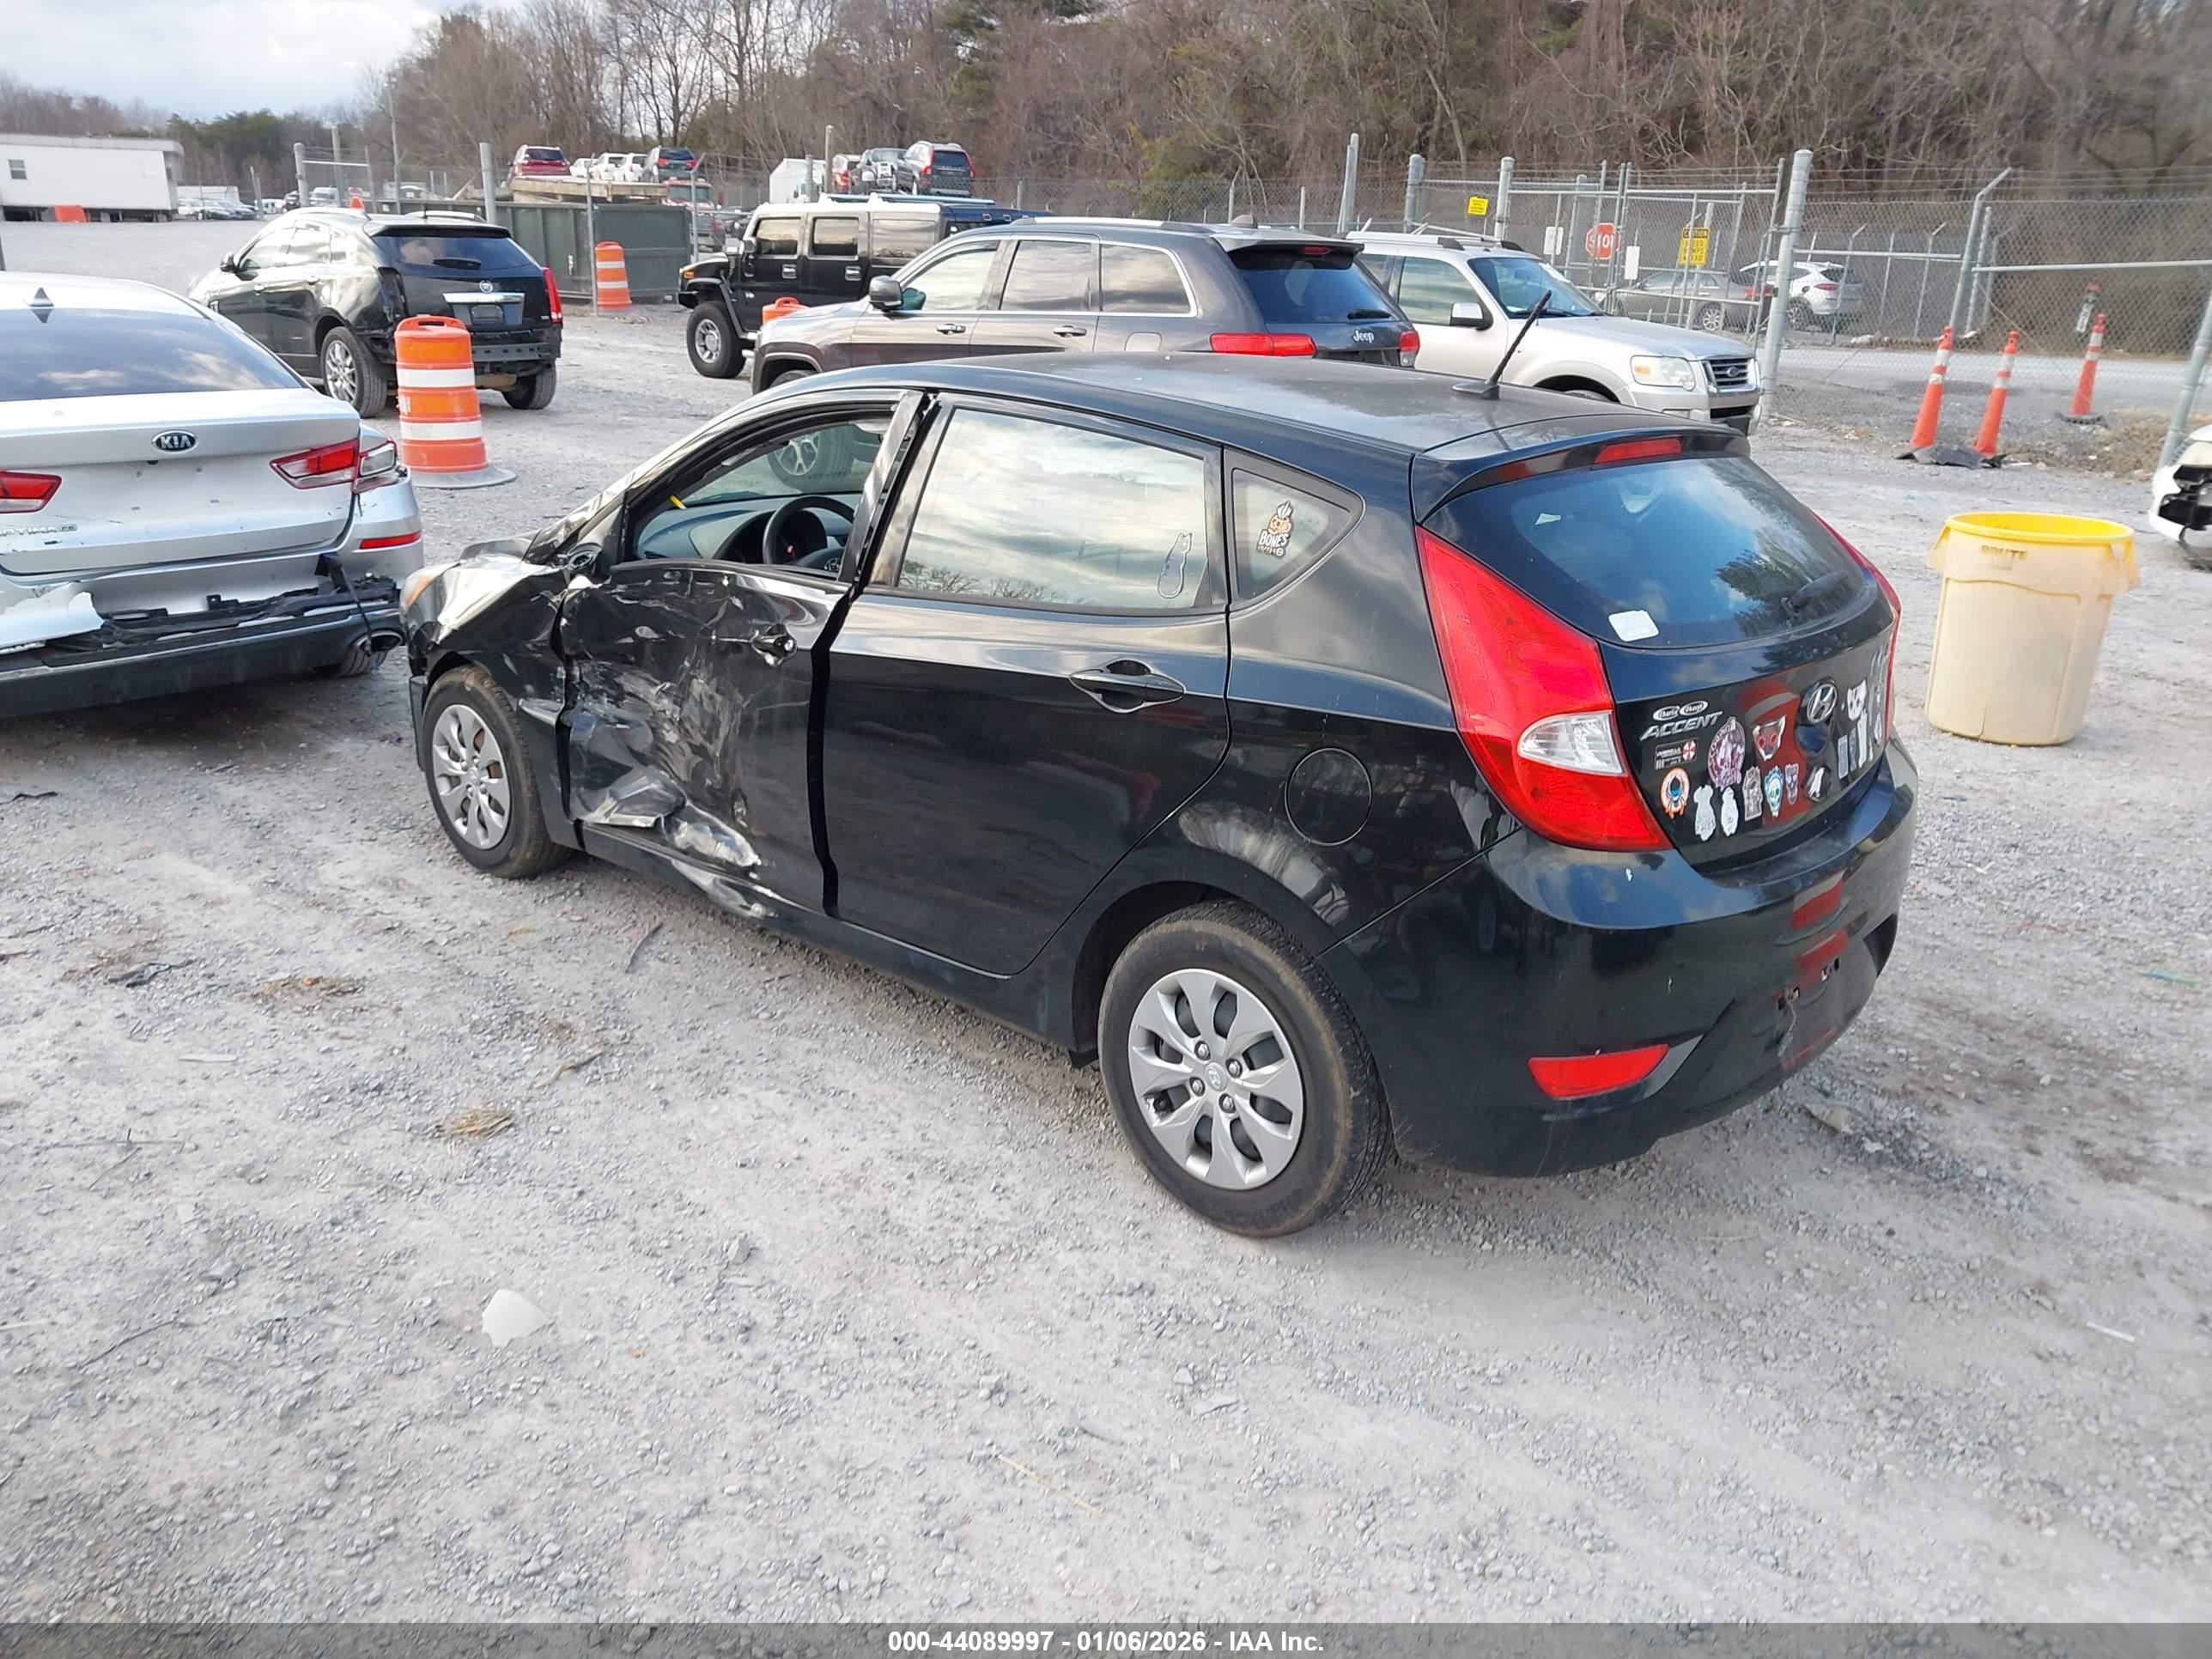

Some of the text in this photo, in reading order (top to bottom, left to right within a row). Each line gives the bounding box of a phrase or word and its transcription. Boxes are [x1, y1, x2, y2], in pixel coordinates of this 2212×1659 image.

[1353, 330, 1374, 343] Jeep
[161, 434, 191, 448] KIA
[1258, 530, 1289, 548] BONES
[1640, 711, 1723, 741] ACCENT
